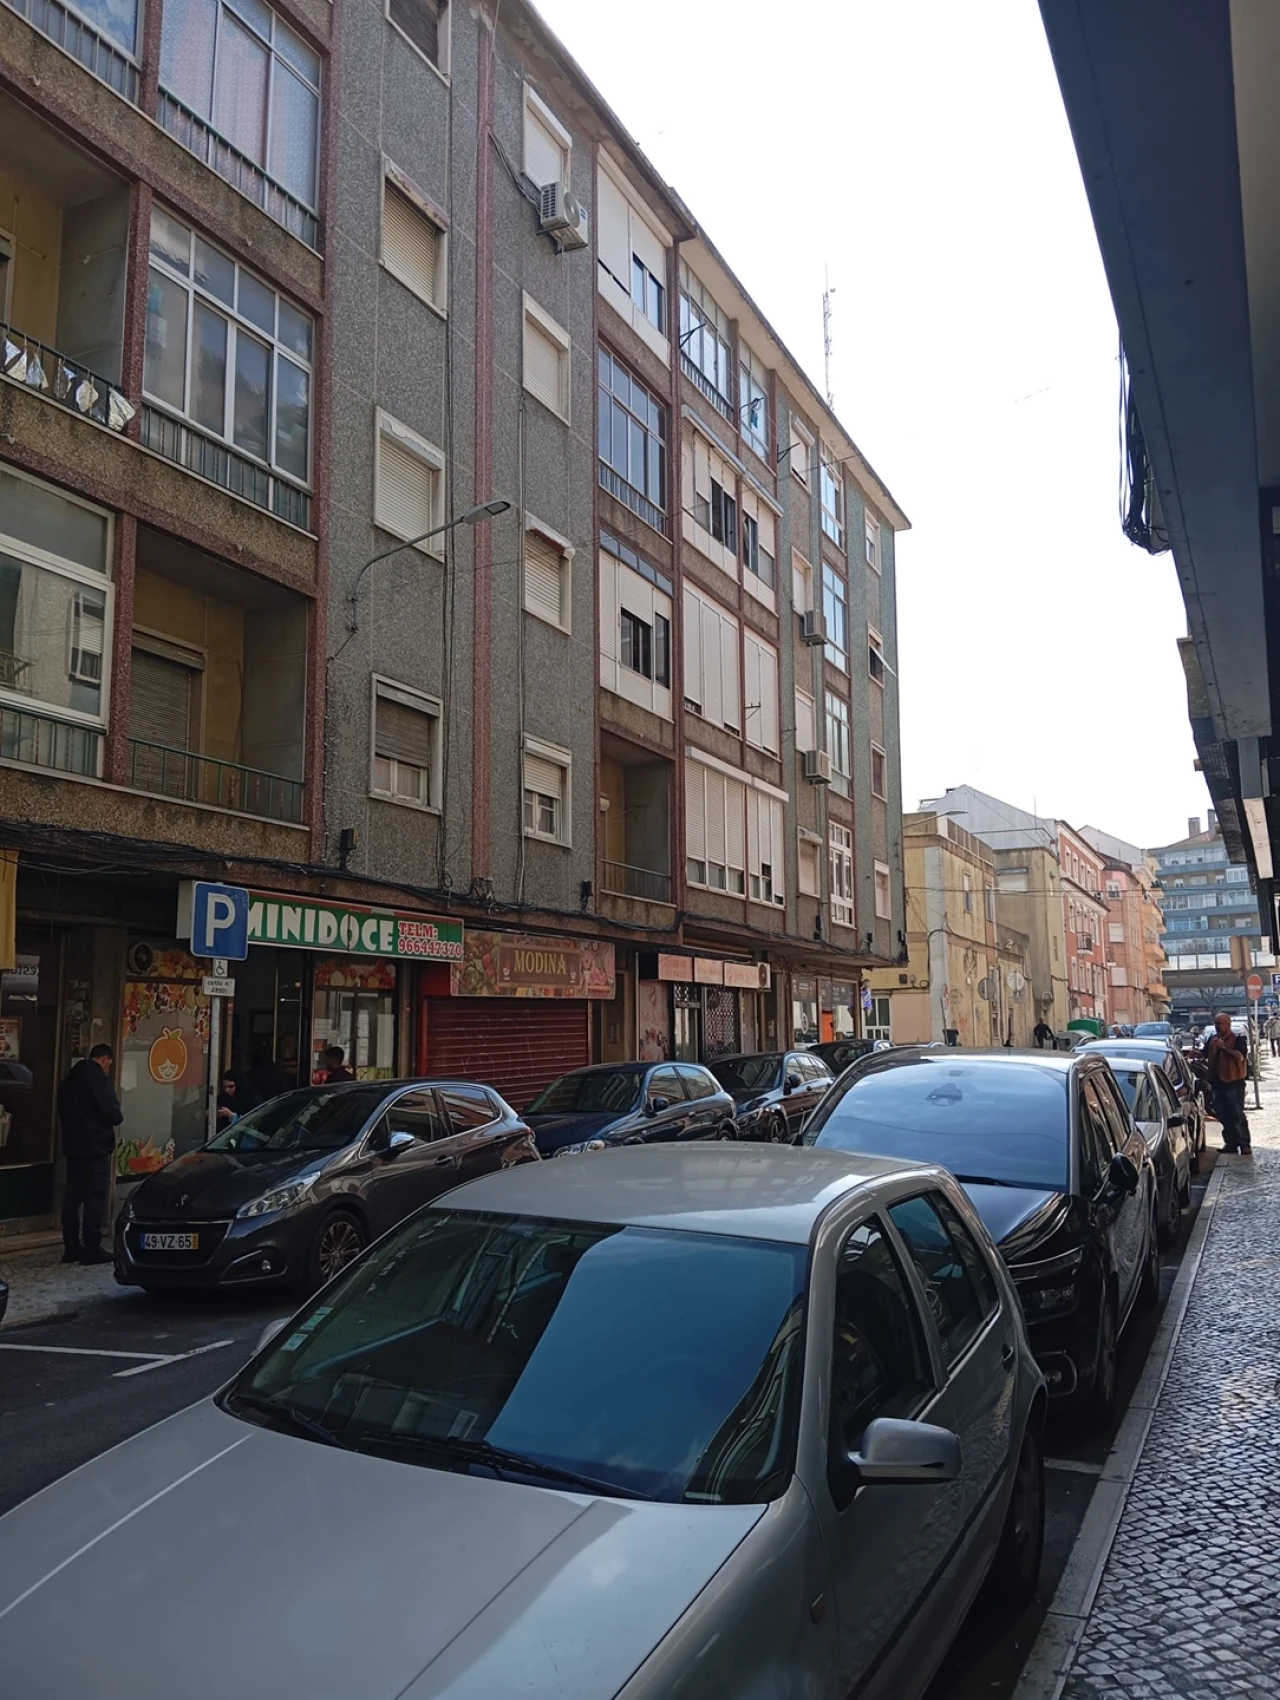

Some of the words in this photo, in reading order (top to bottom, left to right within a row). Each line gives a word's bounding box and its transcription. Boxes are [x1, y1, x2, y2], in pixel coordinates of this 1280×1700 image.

[206, 892, 235, 947] P
[398, 921, 438, 940] TELM:
[514, 950, 567, 975] MODINA
